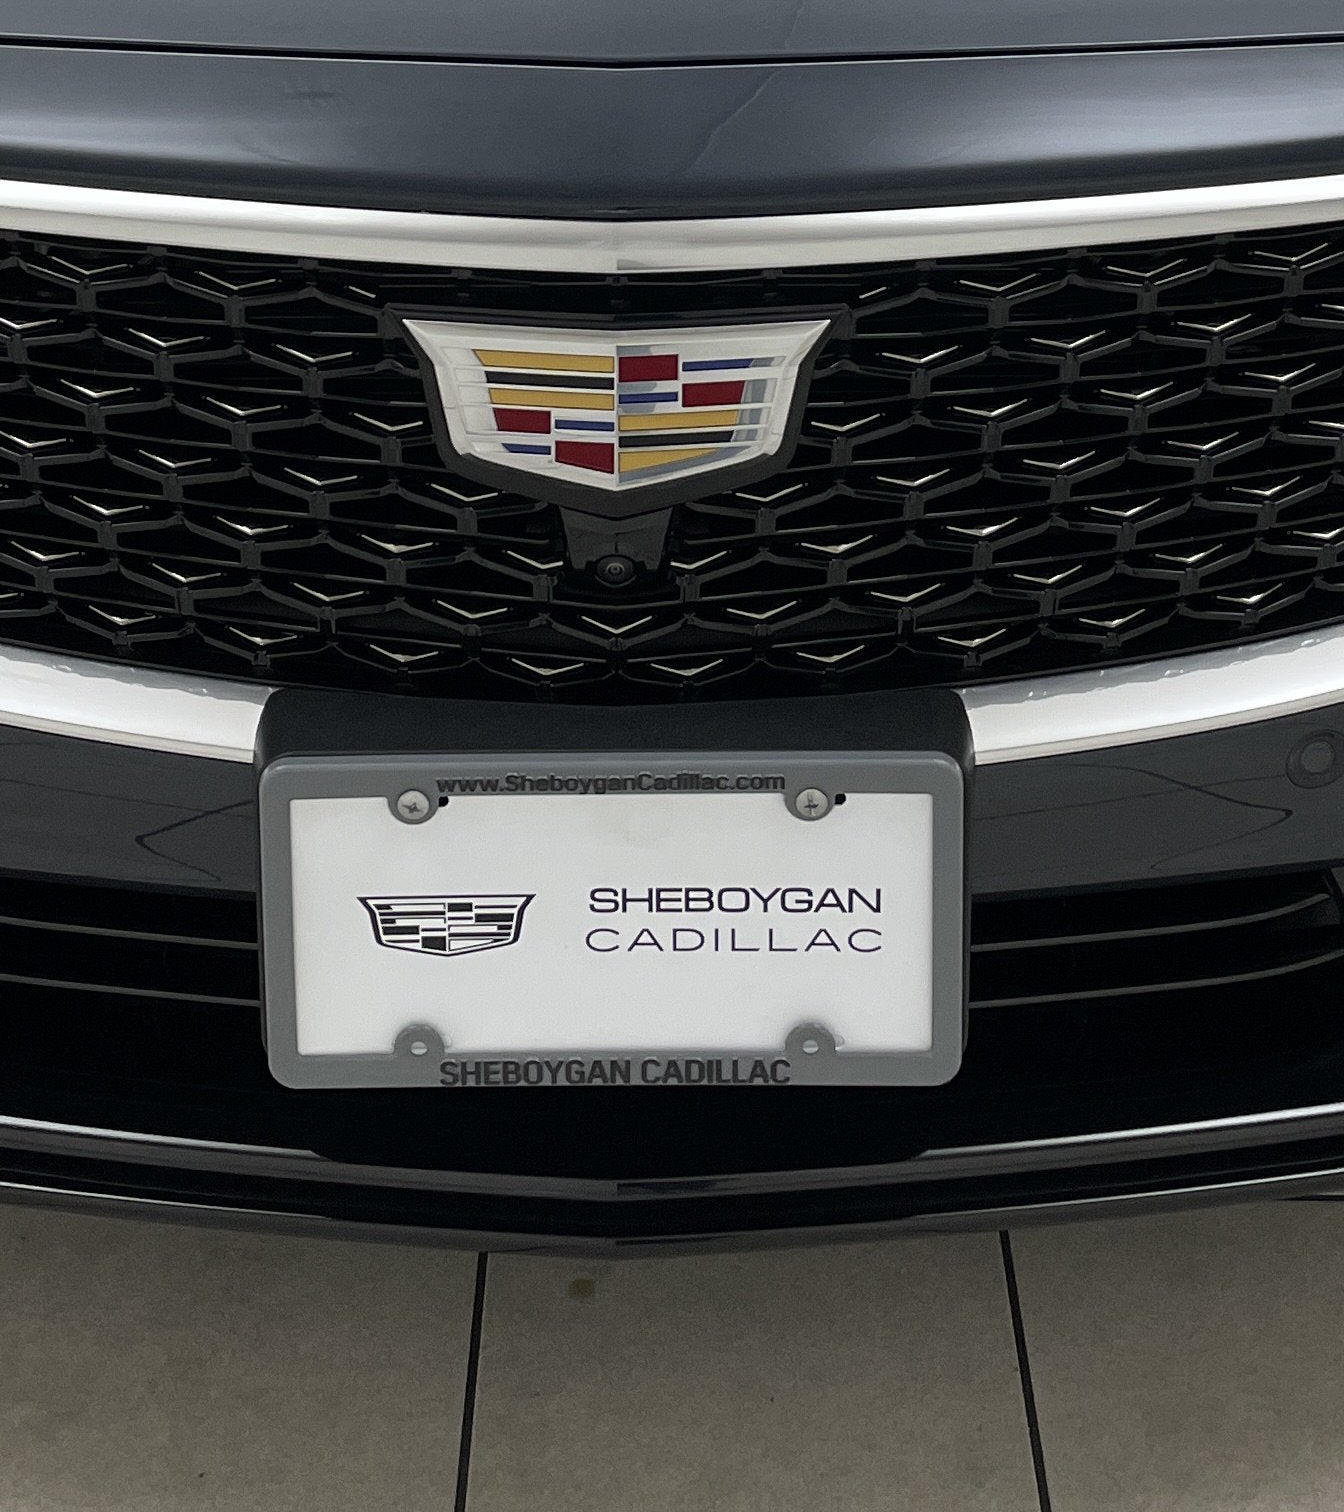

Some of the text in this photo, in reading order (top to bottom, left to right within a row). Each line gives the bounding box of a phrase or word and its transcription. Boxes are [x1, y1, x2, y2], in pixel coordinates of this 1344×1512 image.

[435, 772, 786, 795] www.SheboyganCadillac.com
[588, 887, 882, 914] SHEBOYGAN
[585, 927, 883, 953] CADILLAC
[439, 1057, 792, 1086] SHEBOYGAN CADILLAC
